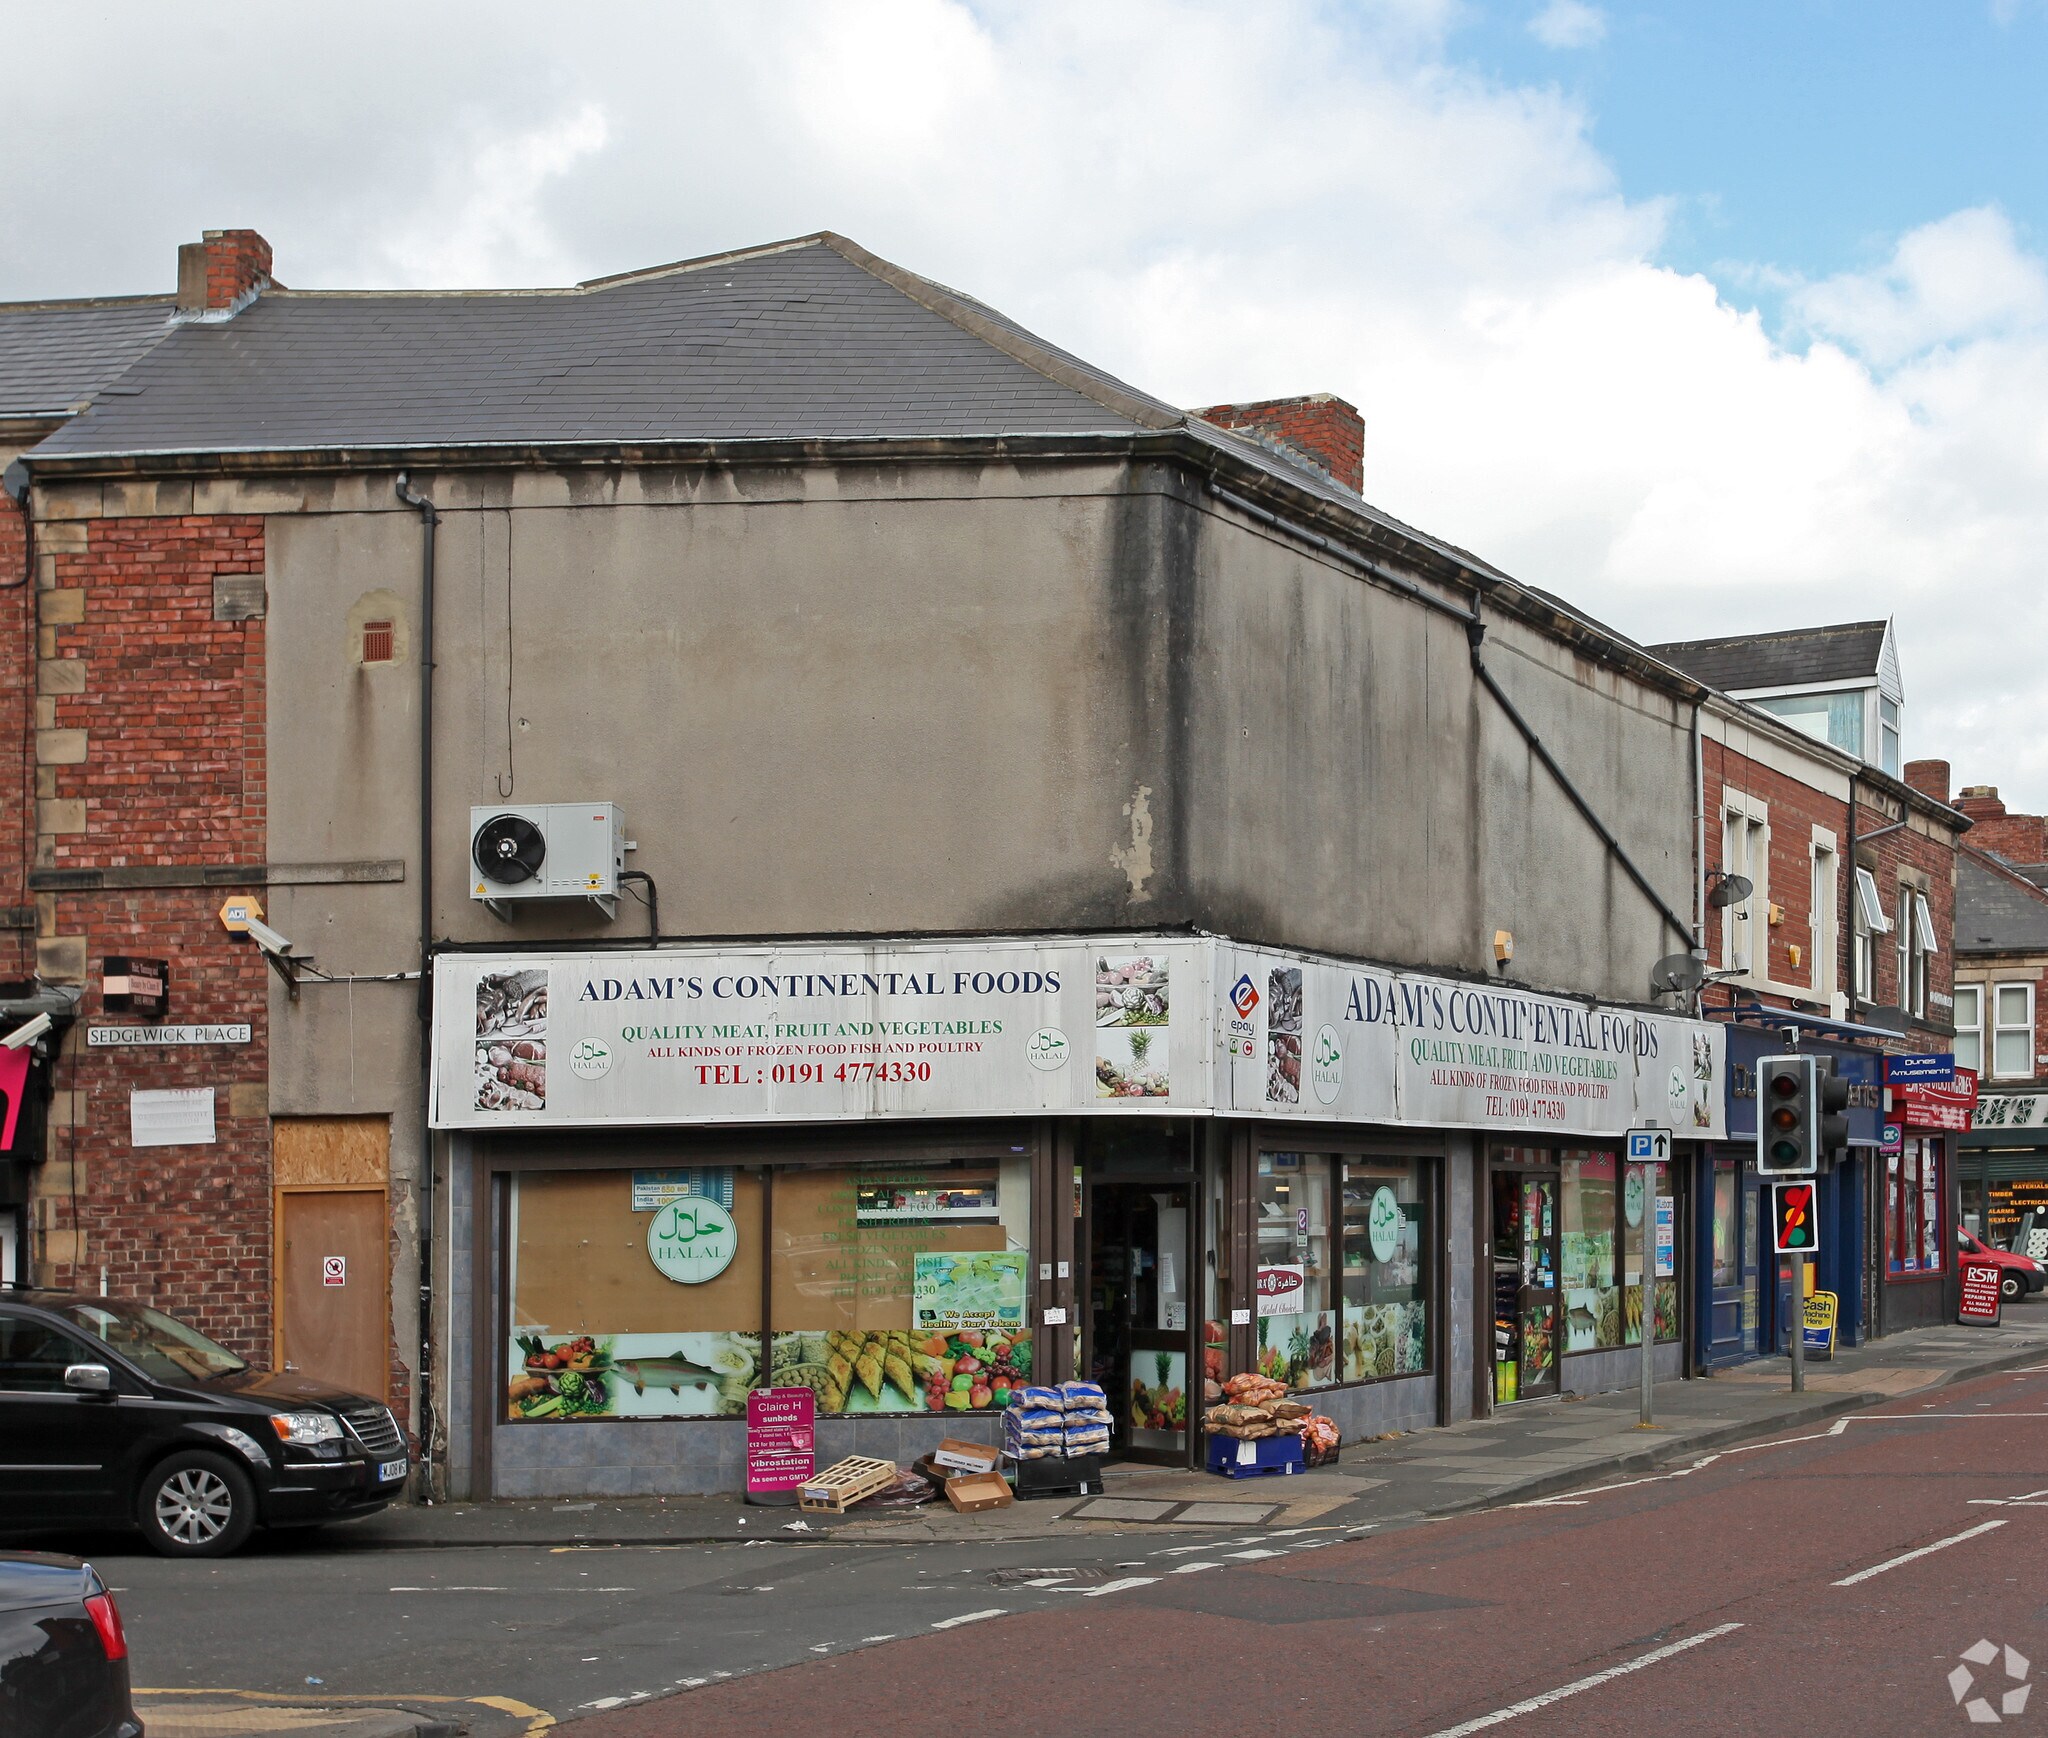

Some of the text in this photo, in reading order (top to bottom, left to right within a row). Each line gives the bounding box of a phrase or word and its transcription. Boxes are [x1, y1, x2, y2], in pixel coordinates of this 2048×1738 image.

[228, 908, 247, 921] ADT
[578, 970, 1061, 1001] ADAM'S CONTINENTAL FOODS
[1344, 976, 1444, 1031] ADAM'S
[621, 1020, 1003, 1043] QUALITY MEAT, FRUIT AND VEGETABLES
[1231, 1020, 1254, 1036] epay
[90, 1027, 247, 1043] SEDGEWICK PLACE
[1031, 1032, 1065, 1050] حلال
[574, 1042, 608, 1060] حلال
[647, 1042, 984, 1058] ALL KINDS OF FROZEN FOOD FISH AND POULTRY
[1030, 1052, 1066, 1060] HALAL
[1316, 1033, 1340, 1067] حلال
[572, 1061, 609, 1070] HALAL
[1411, 1038, 1465, 1065] QUALITY
[1502, 1048, 1528, 1070] FRUIT
[1531, 1050, 1552, 1073] AND
[1553, 1054, 1618, 1080] VEGETABLES
[1904, 1058, 1936, 1066] Dunes
[694, 1065, 750, 1085] TEL
[771, 1064, 824, 1084] 0191
[833, 1062, 931, 1082] 4774330
[1315, 1070, 1340, 1083] HALAL
[1890, 1068, 1951, 1076] Amusements
[1430, 1069, 1449, 1085] ALL
[1449, 1070, 1475, 1088] KINDS
[1476, 1073, 1487, 1088] OF
[1489, 1073, 1517, 1092] FROZEN
[1541, 1080, 1559, 1095] FISH
[1559, 1081, 1576, 1097] AND
[1577, 1083, 1610, 1100] POULTRY
[1485, 1095, 1504, 1116] TEL
[1510, 1098, 1529, 1118] 0191
[1532, 1099, 1566, 1120] 4774330
[1635, 1137, 1648, 1154] P
[846, 1176, 881, 1186] ASIAN
[909, 1202, 951, 1212] FOODS
[1372, 1197, 1395, 1227] حلال
[659, 1207, 724, 1242] حلال
[920, 1216, 930, 1226] &
[822, 1229, 946, 1242] FRESH VEGETABLES
[1372, 1230, 1395, 1242] HALAL
[658, 1246, 726, 1259] HALAL
[841, 1244, 928, 1255] FROZEN FOOD
[825, 1257, 943, 1269] ALL KINDS OF FISH
[840, 1271, 928, 1282] PHONE CARDS
[1967, 1266, 1998, 1283] RSM
[861, 1286, 886, 1296] 0191
[1802, 1299, 1831, 1311] Cash
[944, 1309, 996, 1319] We Accept
[921, 1320, 1021, 1329] Healthy Start Tokens
[1806, 1317, 1823, 1325] Here
[758, 1401, 802, 1412] Claire H
[762, 1414, 798, 1423] sunbeds
[750, 1457, 810, 1467] vibrostation
[778, 1474, 788, 1482] on
[788, 1473, 809, 1481] GMTV
